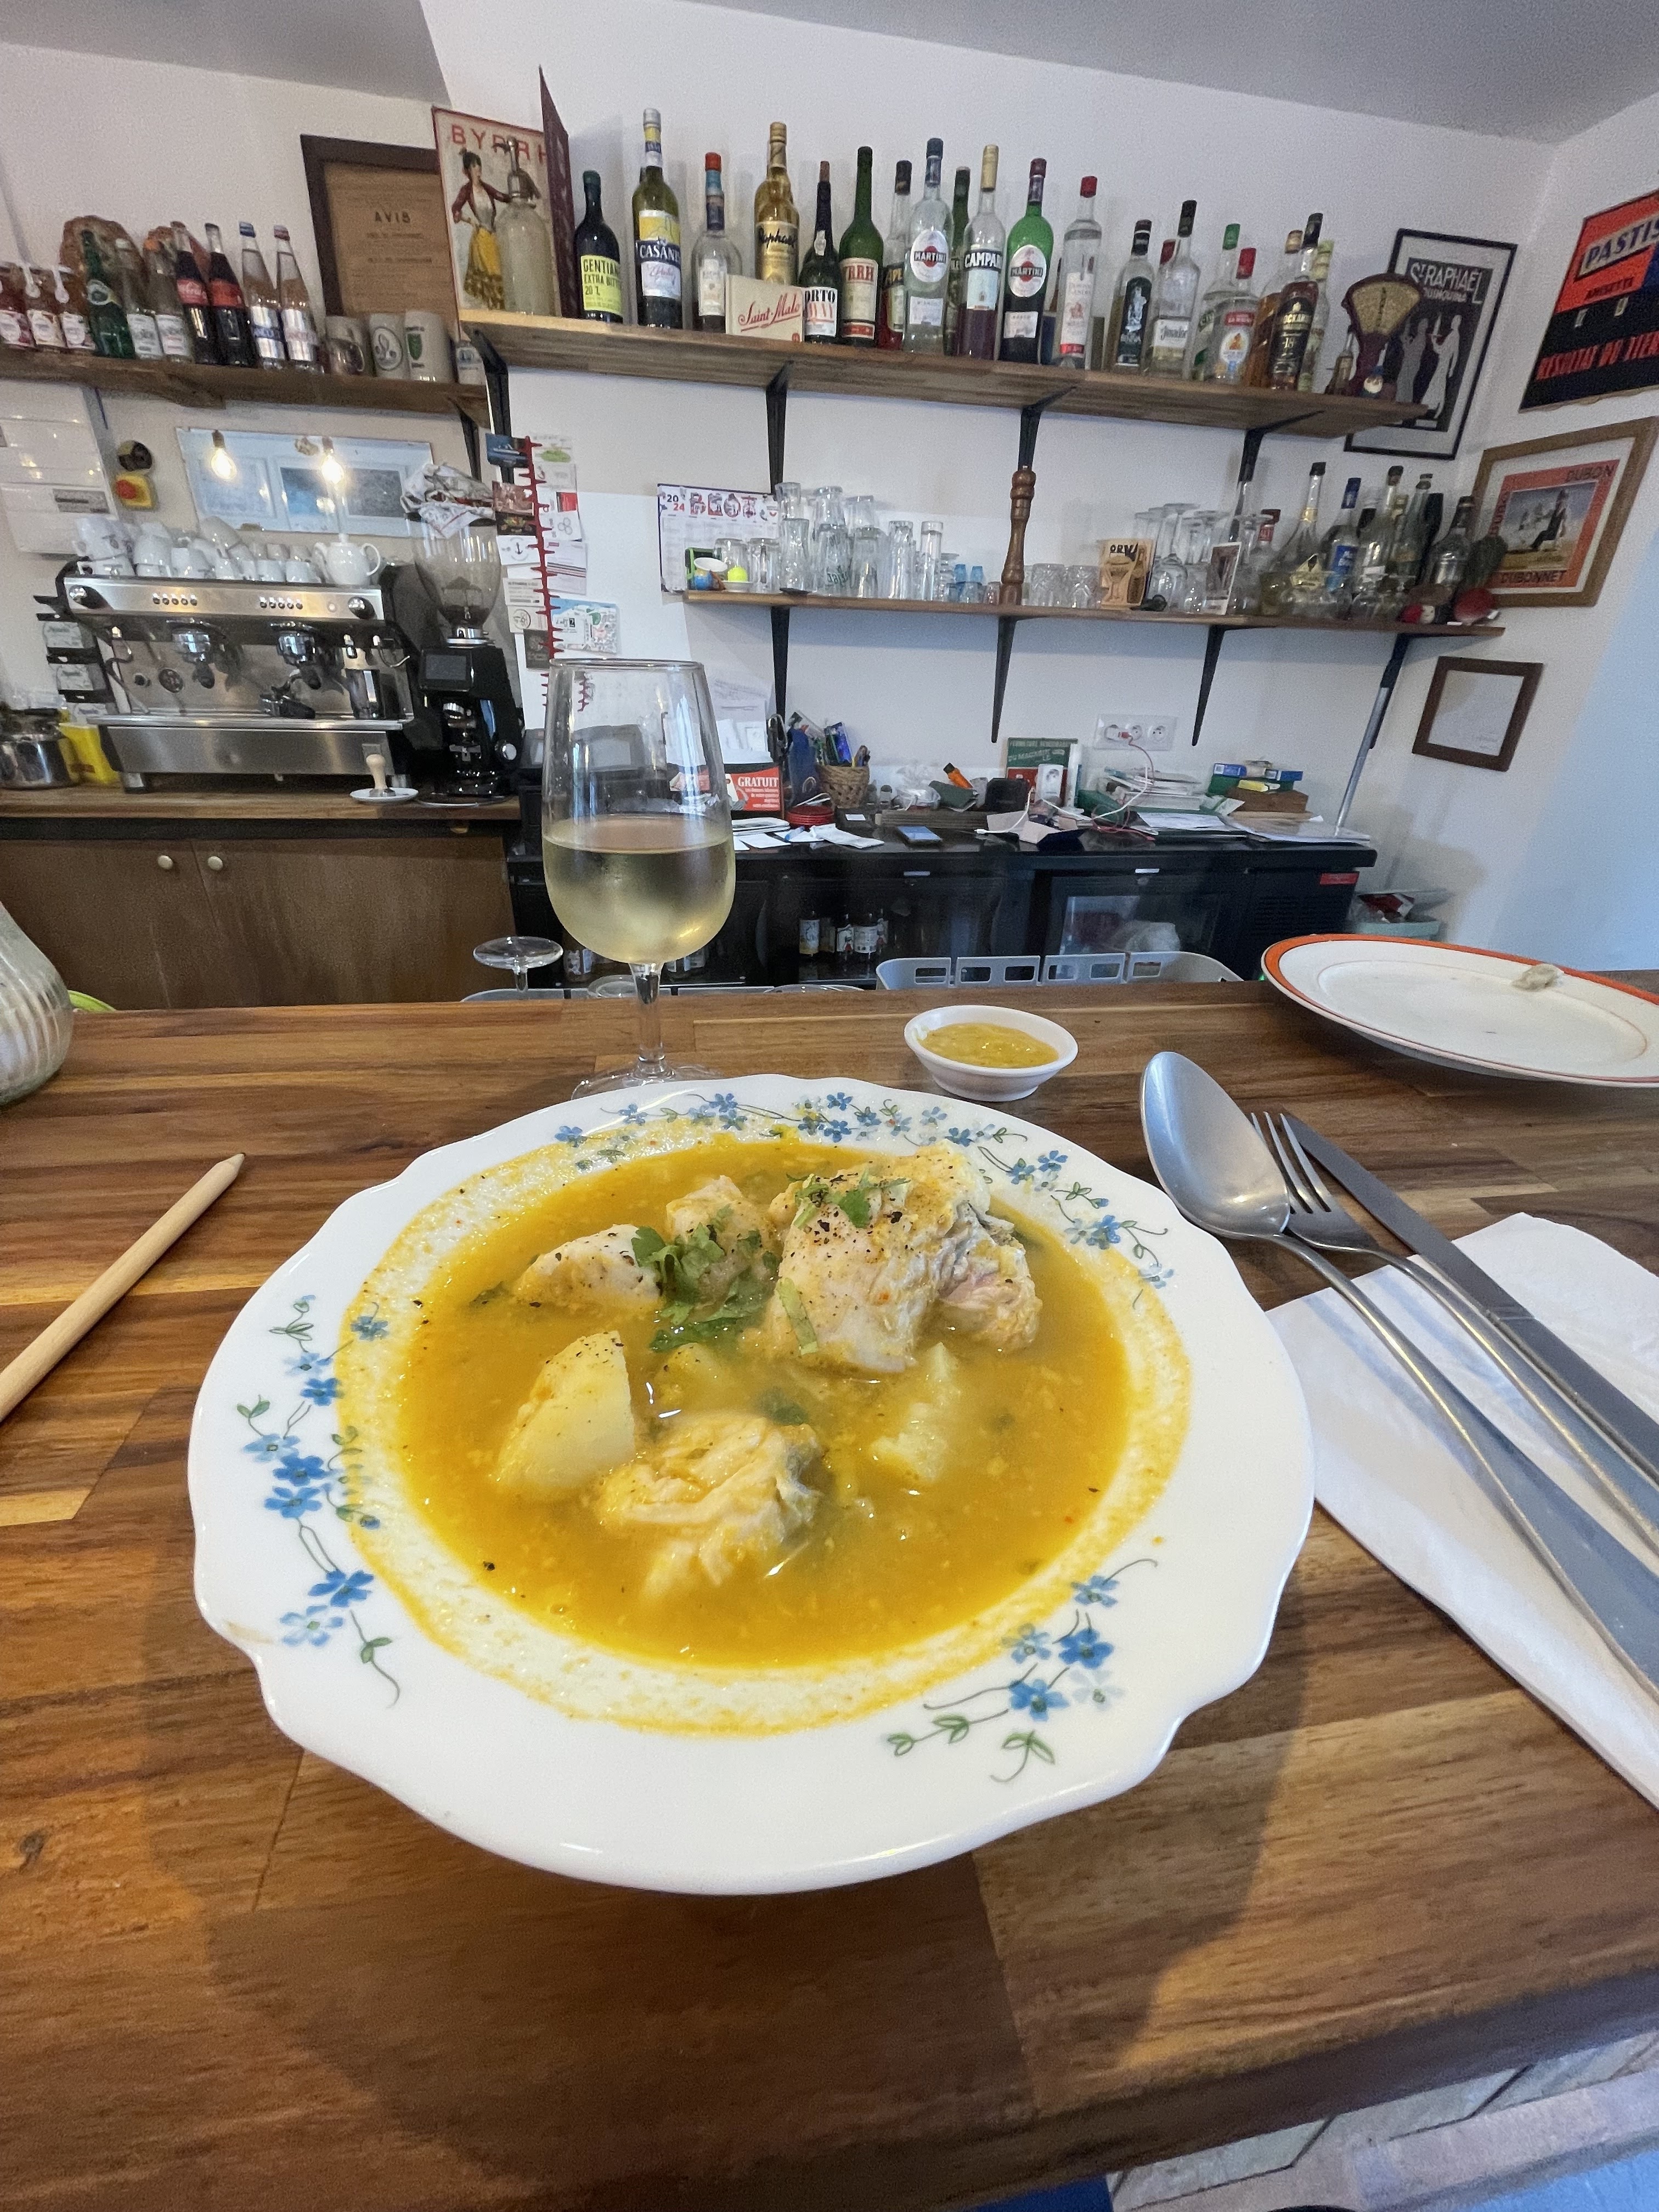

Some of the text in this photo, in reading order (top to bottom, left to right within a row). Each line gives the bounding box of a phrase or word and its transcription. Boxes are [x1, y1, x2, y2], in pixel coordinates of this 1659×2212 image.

[915, 251, 946, 263] MARTINI
[1012, 267, 1043, 277] MARTINI
[585, 285, 593, 295] 20
[667, 494, 679, 503] 20
[673, 503, 685, 512] 24
[737, 776, 778, 787] GRATUIT
